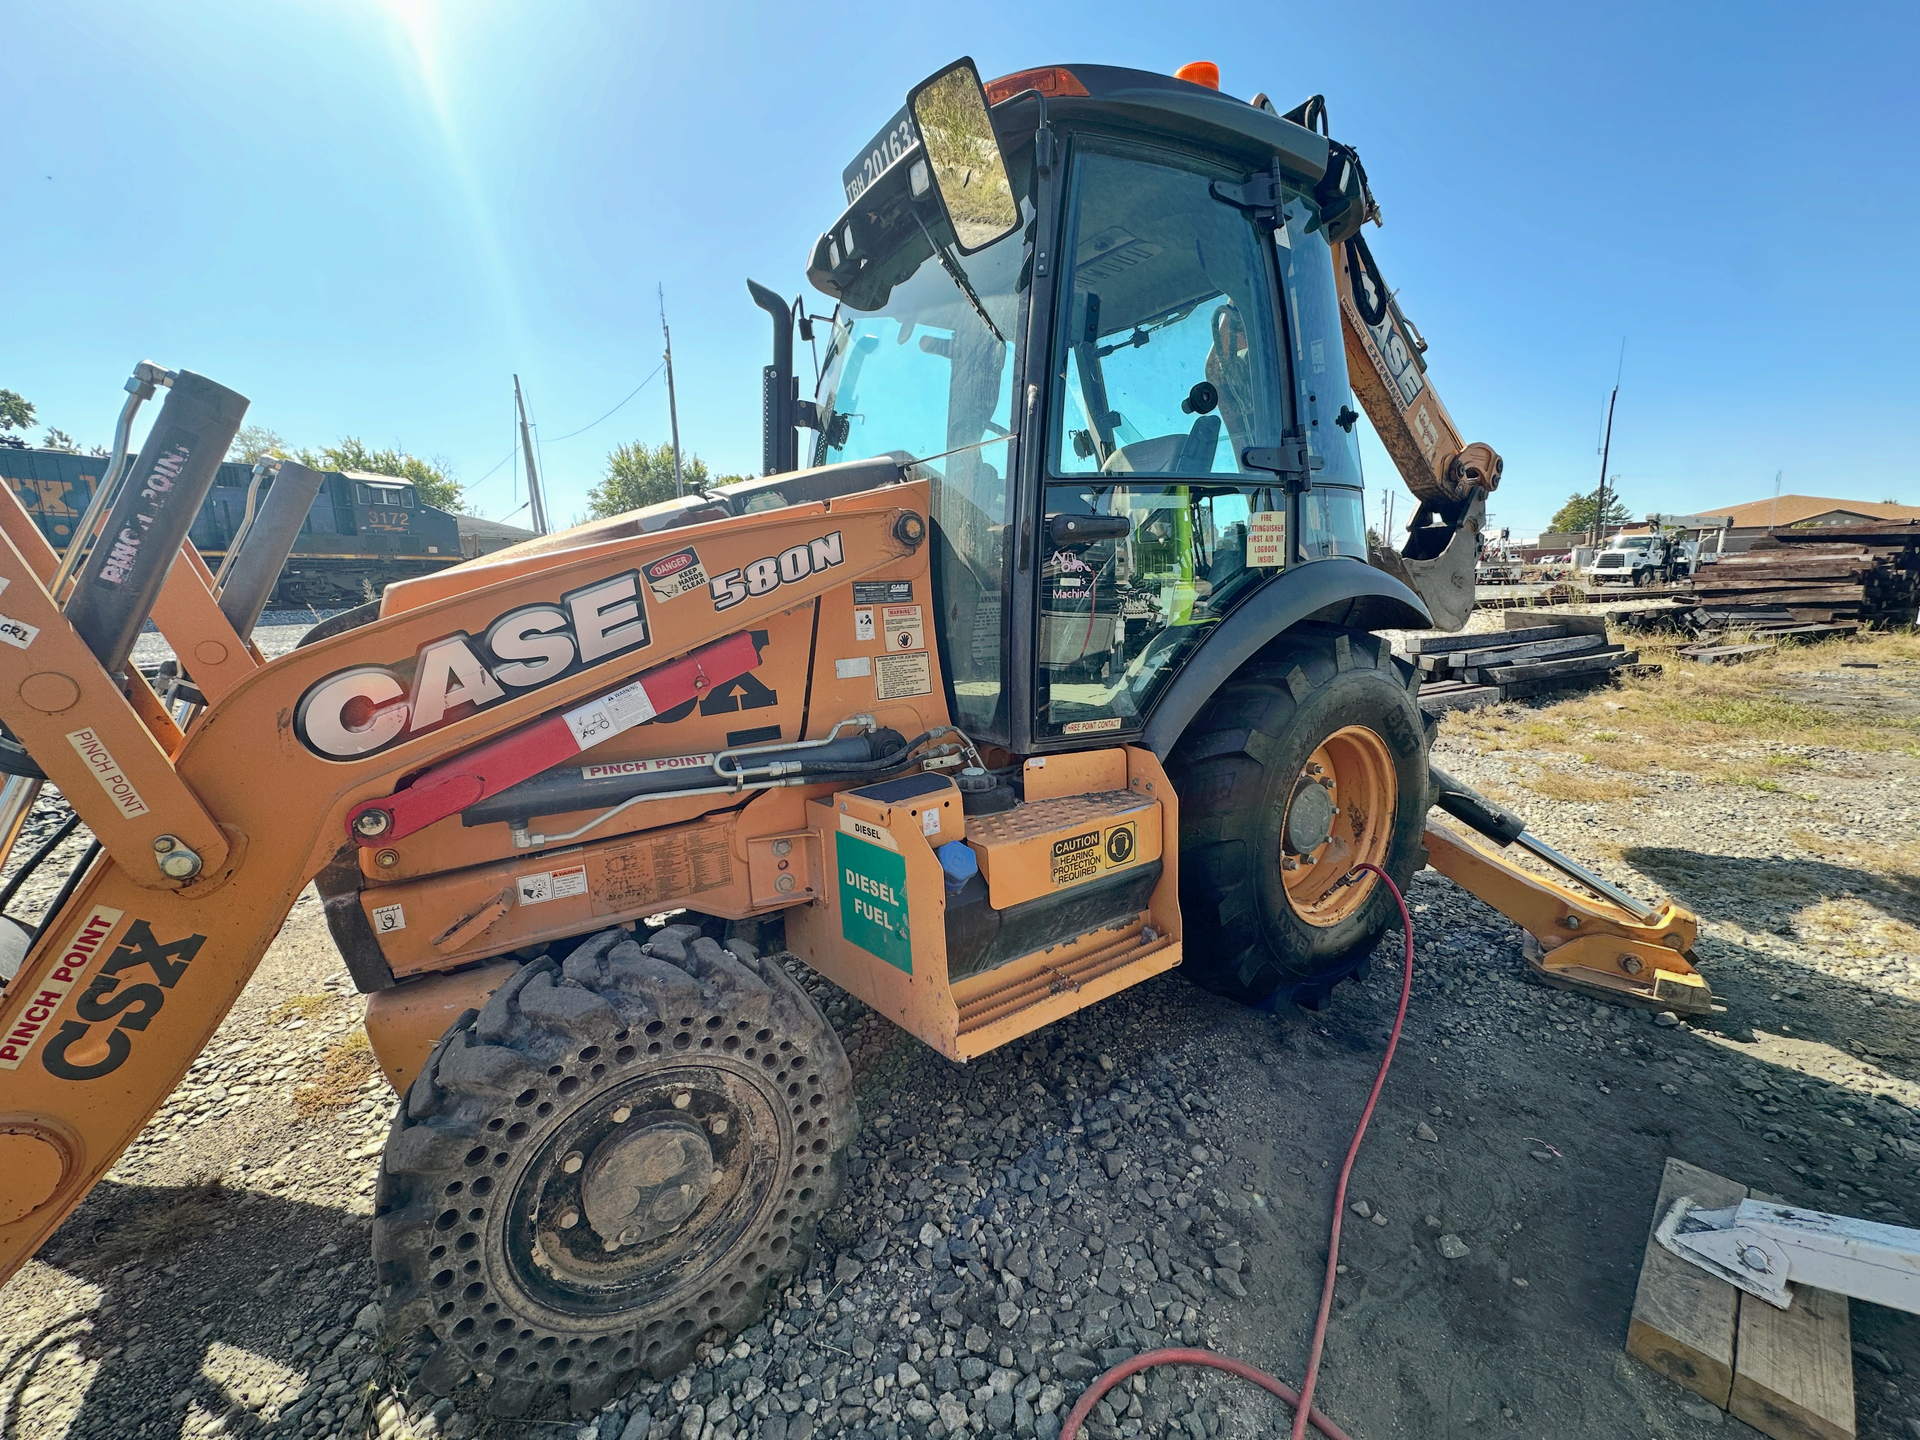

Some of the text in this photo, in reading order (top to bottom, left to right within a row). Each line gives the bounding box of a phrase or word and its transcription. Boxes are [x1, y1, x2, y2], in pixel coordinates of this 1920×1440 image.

[846, 114, 917, 203] TBH 20163
[368, 511, 410, 525] 3172
[1249, 535, 1262, 543] FIRST
[1255, 545, 1278, 553] LOGBOOK
[655, 556, 688, 576] DANGER
[679, 567, 698, 579] KEEP
[709, 531, 844, 612] 580N
[678, 572, 704, 586] HANDS
[682, 578, 706, 591] CLEAR
[1052, 589, 1090, 599] Machine
[302, 573, 648, 758] CASE
[614, 684, 639, 698] WARNING
[1067, 719, 1120, 732] HREE POINT CONTACT
[74, 731, 145, 813] PINCH POINT
[590, 756, 707, 777] PINCH POINT
[855, 823, 881, 840] DIESEL
[1055, 833, 1098, 854] CAUTION
[1053, 855, 1101, 877] PROTECTION
[1060, 849, 1094, 865] HEARING
[559, 868, 583, 876] WARNING
[1058, 865, 1097, 884] REQUIRED
[845, 868, 899, 907] DIESEL
[854, 897, 893, 931] FUEL
[0, 915, 112, 1061] PINCH POINT
[42, 918, 208, 1081] CSX
